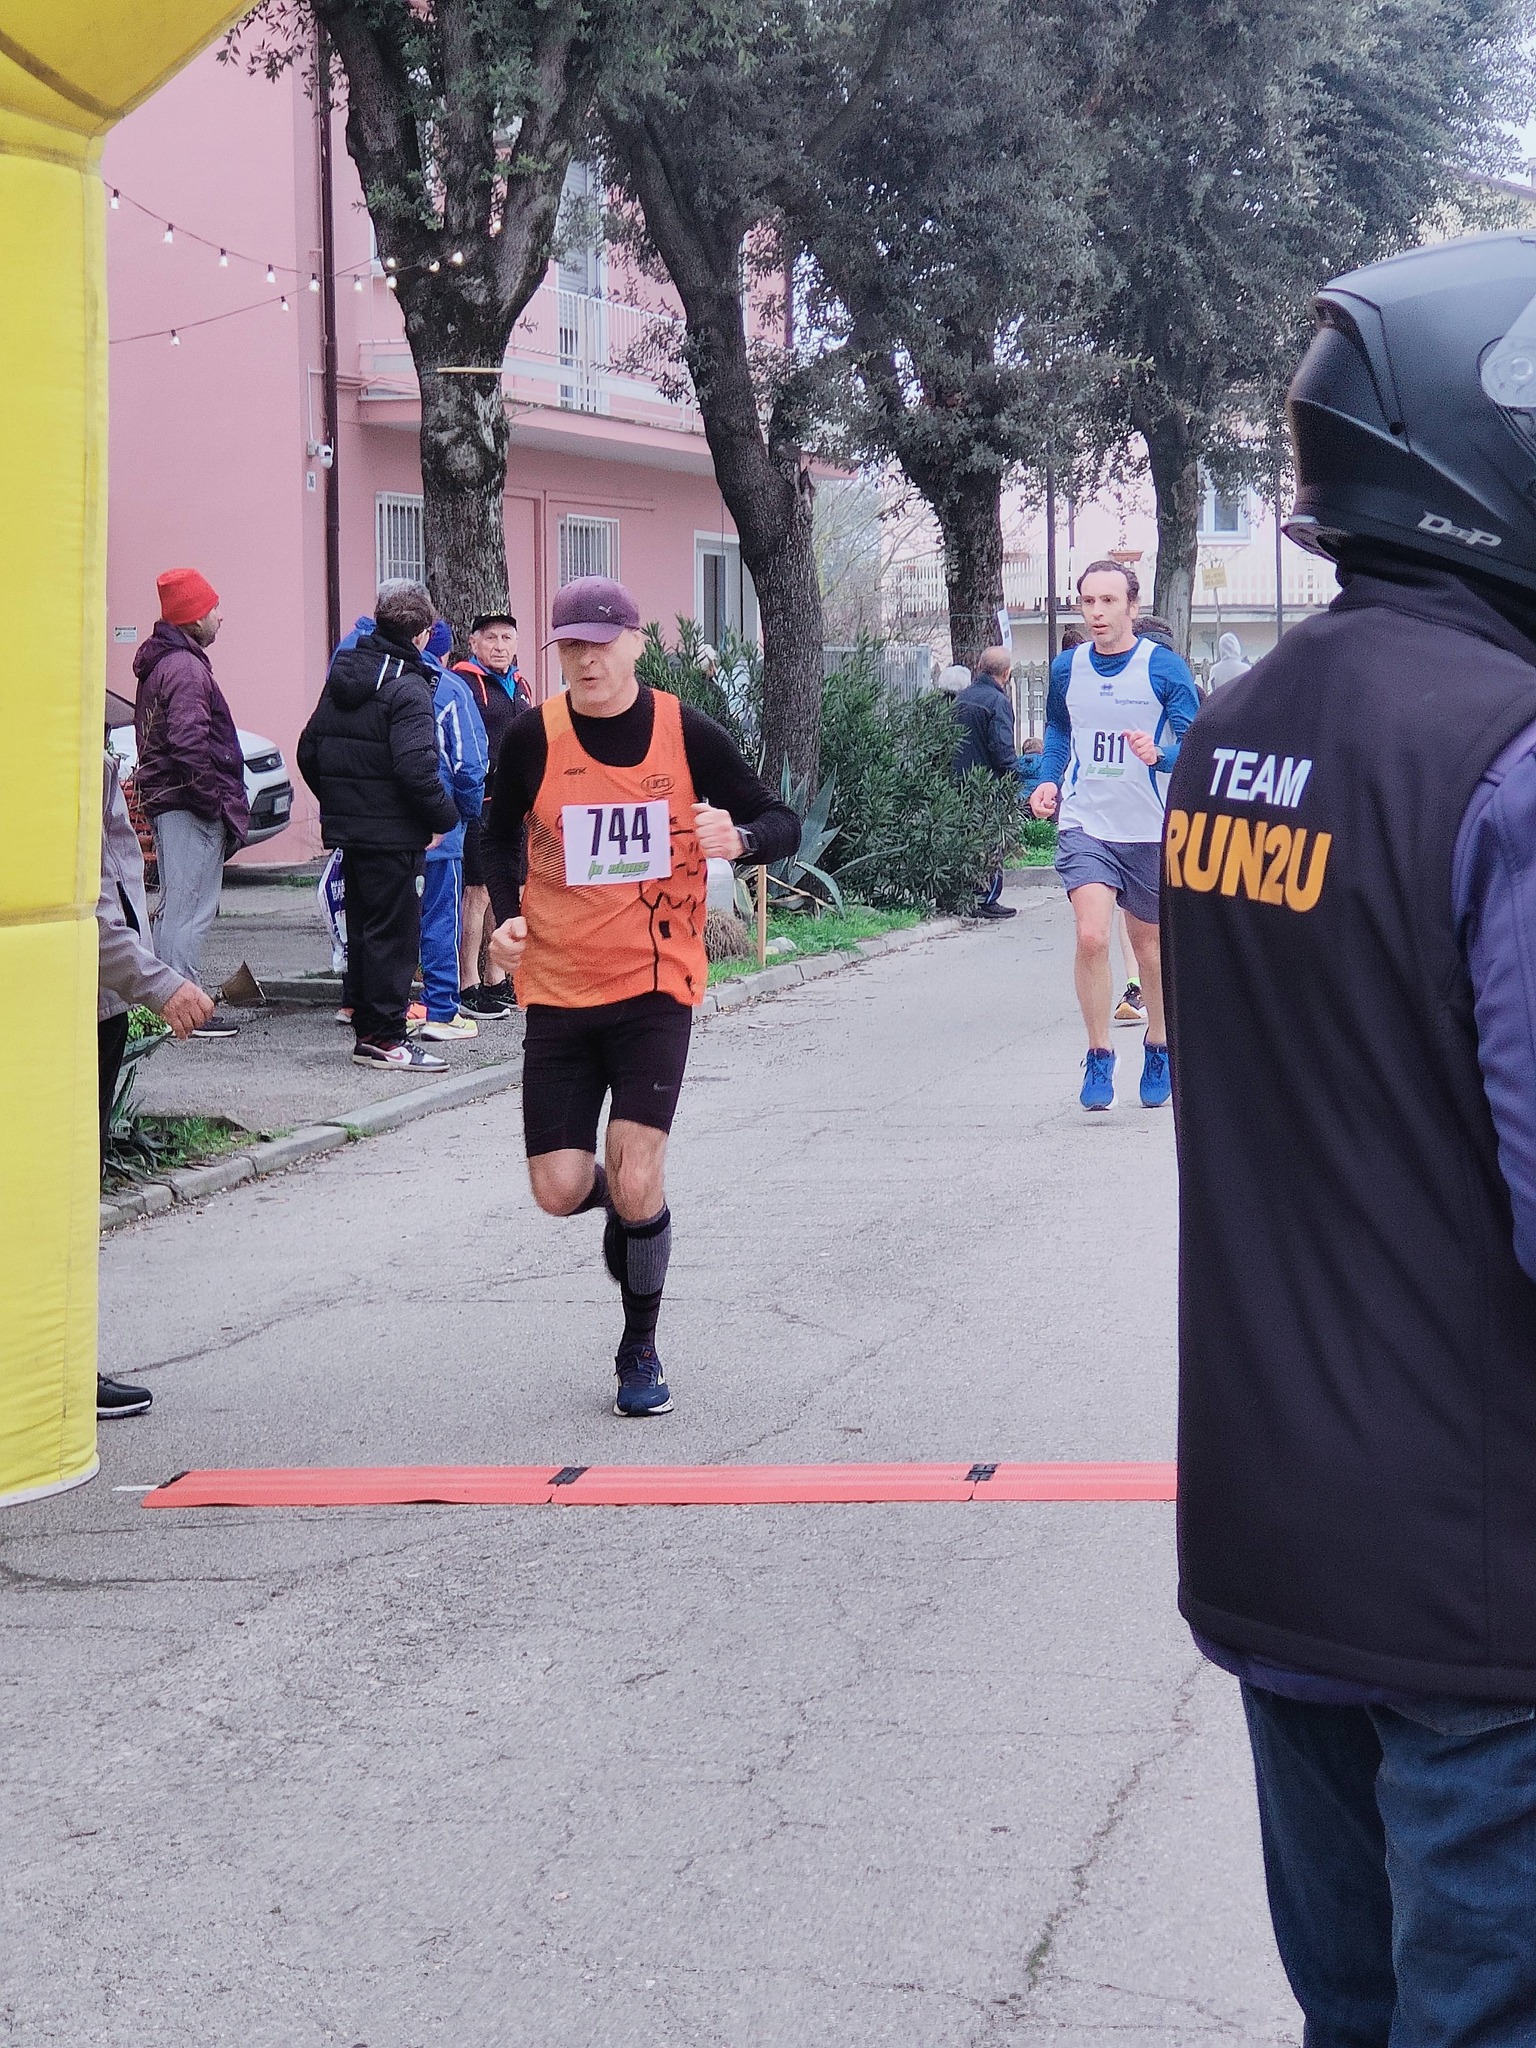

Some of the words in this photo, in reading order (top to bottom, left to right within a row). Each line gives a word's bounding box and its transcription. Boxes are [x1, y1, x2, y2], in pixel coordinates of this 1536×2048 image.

[1093, 731, 1125, 764] 611
[1210, 748, 1313, 808] TEAM
[587, 806, 651, 856] 744
[1165, 809, 1332, 913] RUN2U
